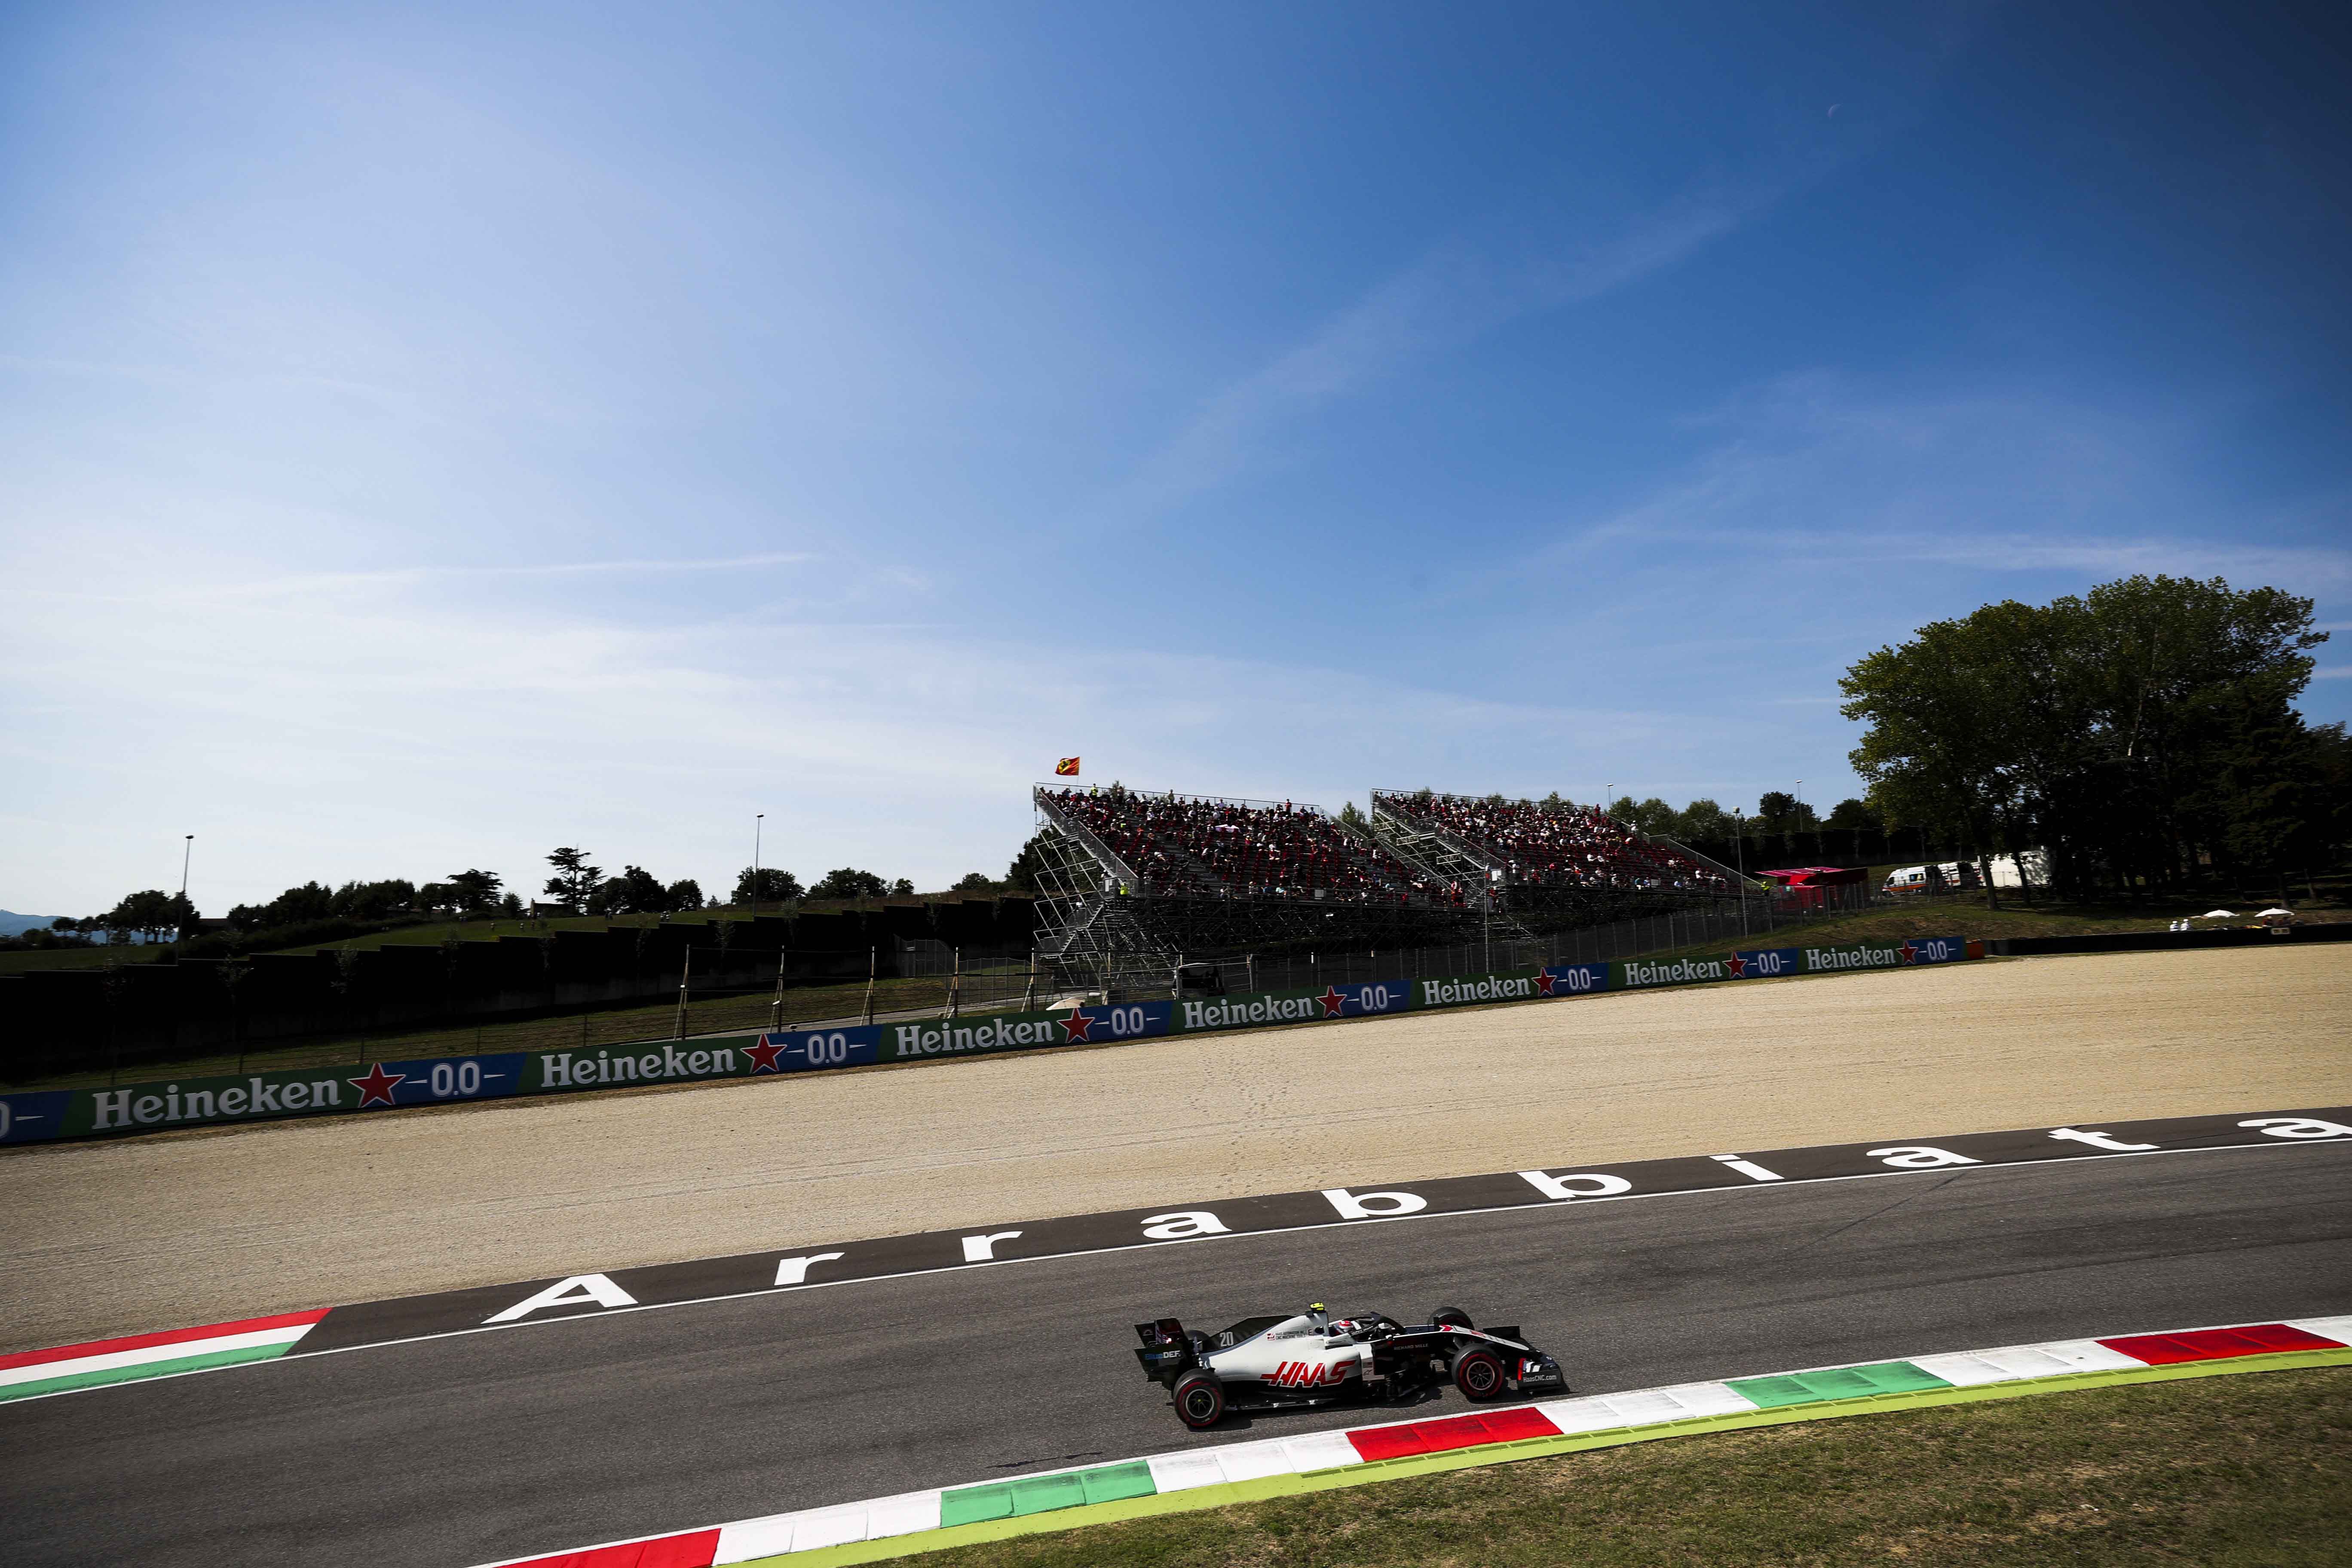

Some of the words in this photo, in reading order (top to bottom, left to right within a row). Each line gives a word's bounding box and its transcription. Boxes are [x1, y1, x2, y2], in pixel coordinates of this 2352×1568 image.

[1624, 959, 1722, 985] Heineken
[1758, 952, 1780, 974] 0.0
[1806, 946, 1896, 970] Heineken
[1927, 940, 1948, 961] 0.0
[1422, 976, 1531, 1005] Heineken
[1568, 968, 1591, 989] 0.0
[1182, 995, 1314, 1028] Heineken
[1361, 985, 1388, 1011] 0.0
[895, 1018, 1054, 1056] Heineken
[1111, 1007, 1144, 1036] 0.0
[541, 1046, 736, 1087] Heineken
[807, 1032, 847, 1065] 0.0
[92, 1078, 341, 1130] Heineken
[431, 1060, 480, 1097] 0.0
[1220, 1332, 1234, 1347] 20
[1260, 1360, 1356, 1387] HAAS
